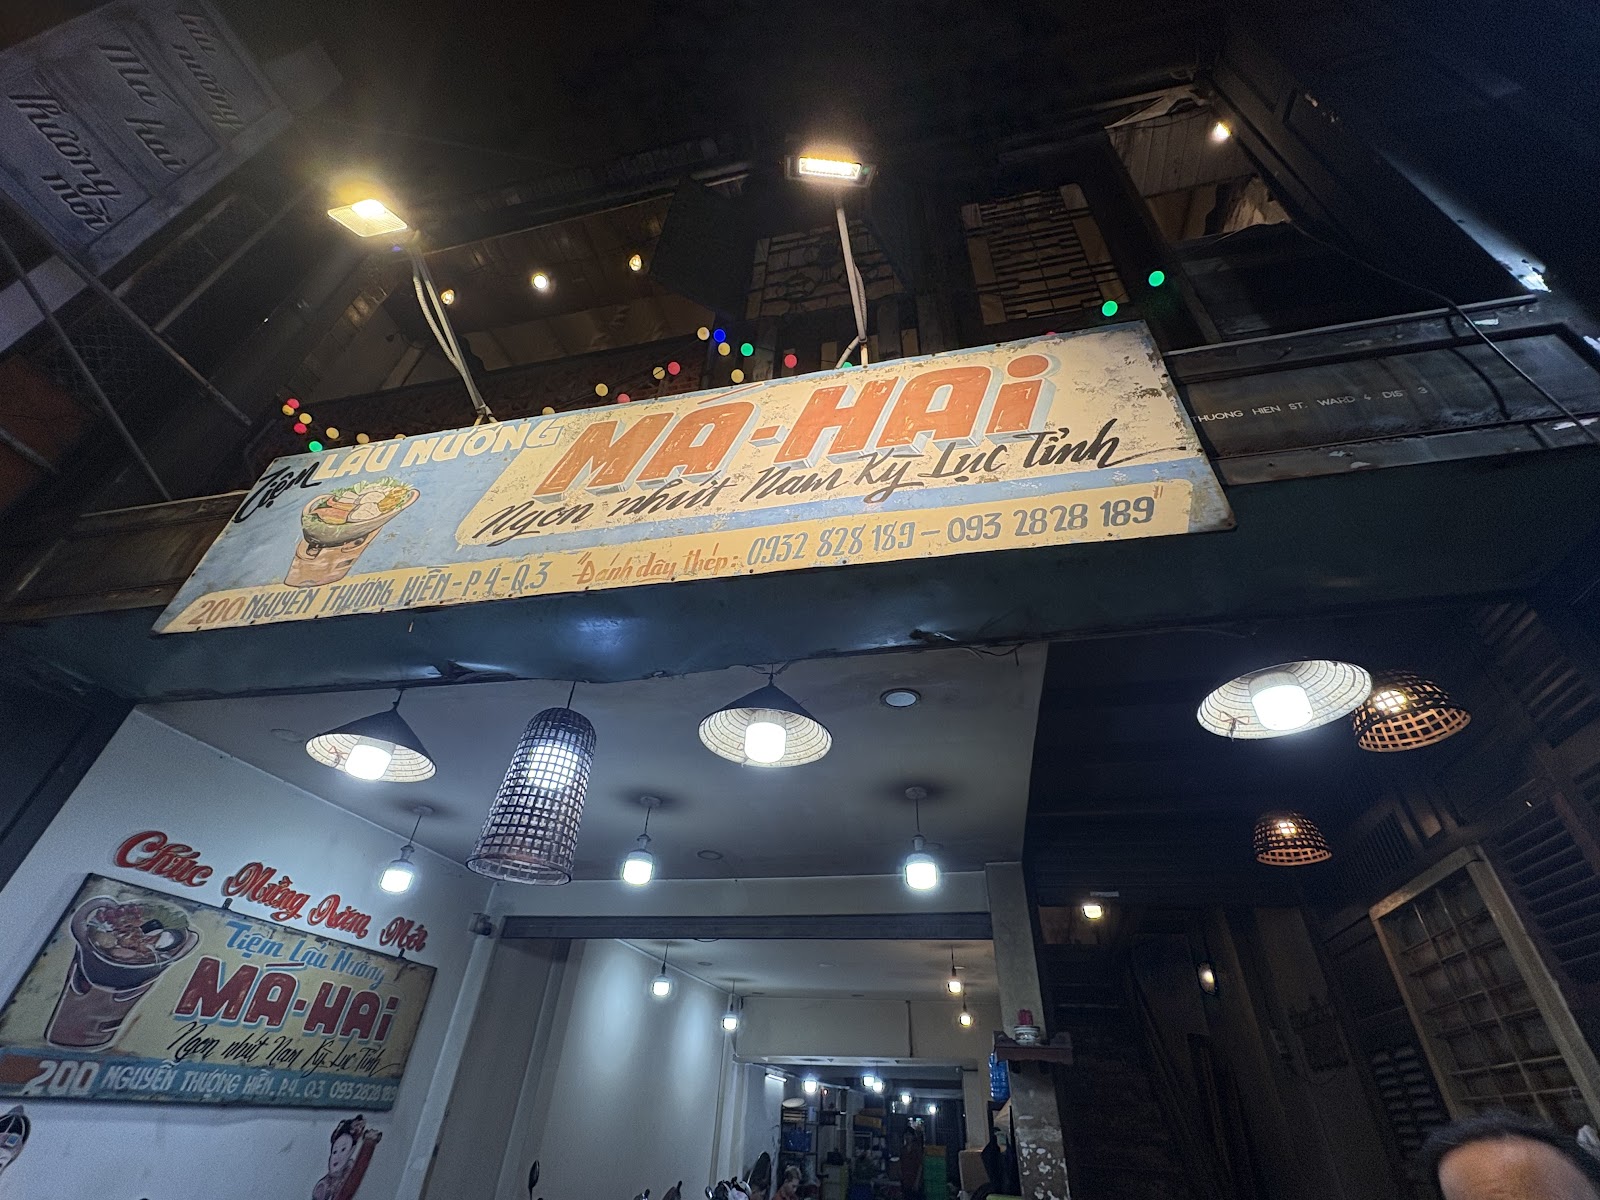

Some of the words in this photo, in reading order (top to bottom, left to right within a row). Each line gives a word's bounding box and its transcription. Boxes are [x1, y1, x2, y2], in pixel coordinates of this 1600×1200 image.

[124, 117, 188, 174] hai
[1252, 404, 1282, 416] HIEN
[1317, 395, 1356, 407] WARD
[1417, 386, 1428, 394] 3
[233, 461, 322, 523] Tiệm
[471, 499, 594, 547] Ngon
[739, 466, 850, 502] Nam
[917, 441, 1008, 483] Lục
[1013, 418, 1187, 468] Tỉnh
[187, 596, 247, 625] 200
[635, 552, 678, 579] dây
[747, 532, 808, 565] 0932
[816, 523, 868, 557] 828
[871, 521, 916, 551] 189
[947, 512, 1003, 543] 093
[1013, 503, 1088, 537] 2828
[112, 830, 214, 888] Chúc
[307, 894, 372, 939] Năm
[225, 920, 284, 958] Tiệm
[288, 939, 329, 969] Lẩu
[166, 1021, 220, 1062] Ngon
[265, 1035, 303, 1069] Nam
[24, 1060, 99, 1096] 200
[101, 1059, 181, 1091] NGUYỄN
[179, 1068, 242, 1099] THƯỢNG
